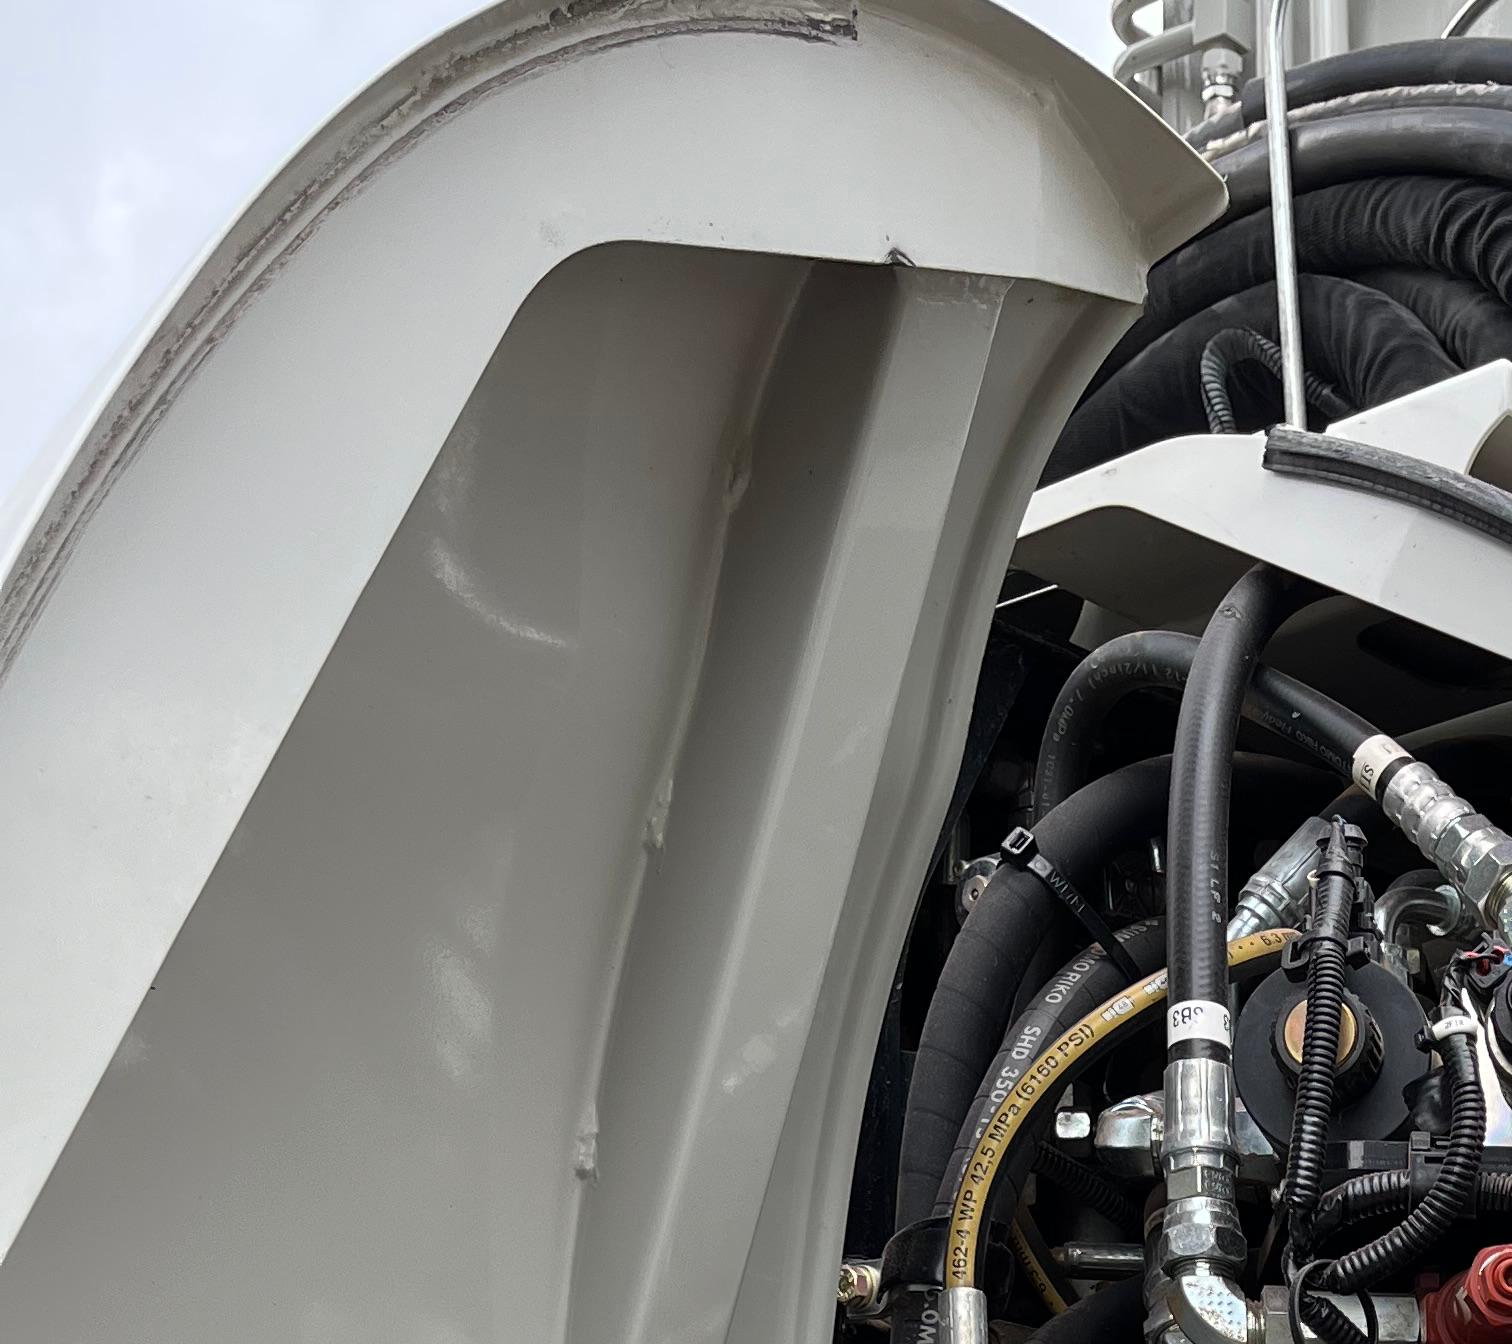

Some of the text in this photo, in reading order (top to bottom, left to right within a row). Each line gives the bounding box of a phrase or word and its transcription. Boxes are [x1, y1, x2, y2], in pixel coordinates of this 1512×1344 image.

[1045, 970, 1082, 1004] RIKO
[1011, 1024, 1042, 1062] SHD
[1056, 1022, 1097, 1059] PSI)
[1015, 1055, 1060, 1102] (6160
[988, 1102, 1022, 1143] MPa
[957, 1189, 979, 1223] WP
[951, 1226, 972, 1281] 462-4
